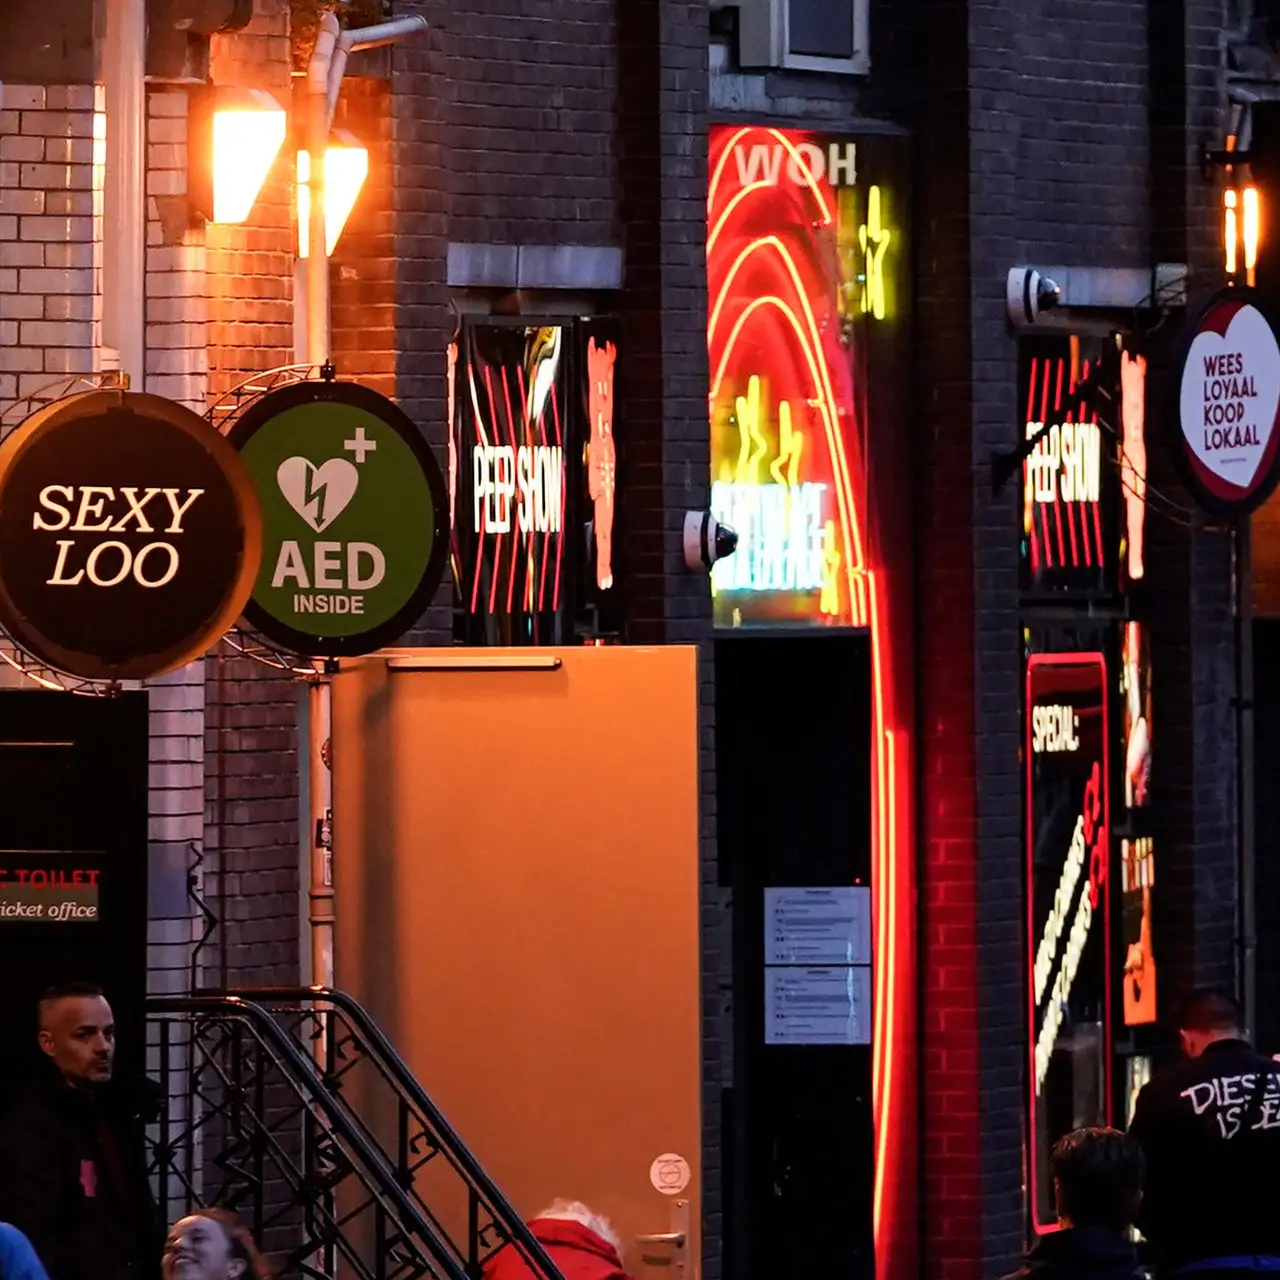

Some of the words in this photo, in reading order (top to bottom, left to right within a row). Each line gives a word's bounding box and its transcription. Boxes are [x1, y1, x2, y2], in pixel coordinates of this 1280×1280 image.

[1204, 353, 1243, 376] WEES
[1204, 375, 1258, 401] LOYAAL
[1204, 402, 1245, 426] KOOP
[1204, 425, 1261, 451] LOKAAL
[1061, 422, 1101, 503] SHOW
[473, 445, 516, 534] PEEP
[517, 445, 563, 533] SHOW
[32, 484, 205, 534] SEXY
[45, 540, 180, 588] LOO
[271, 541, 387, 591] AED
[293, 594, 365, 615] INSIDE
[14, 869, 100, 890] TOILET
[48, 902, 97, 921] office
[1216, 1106, 1242, 1139] IS
